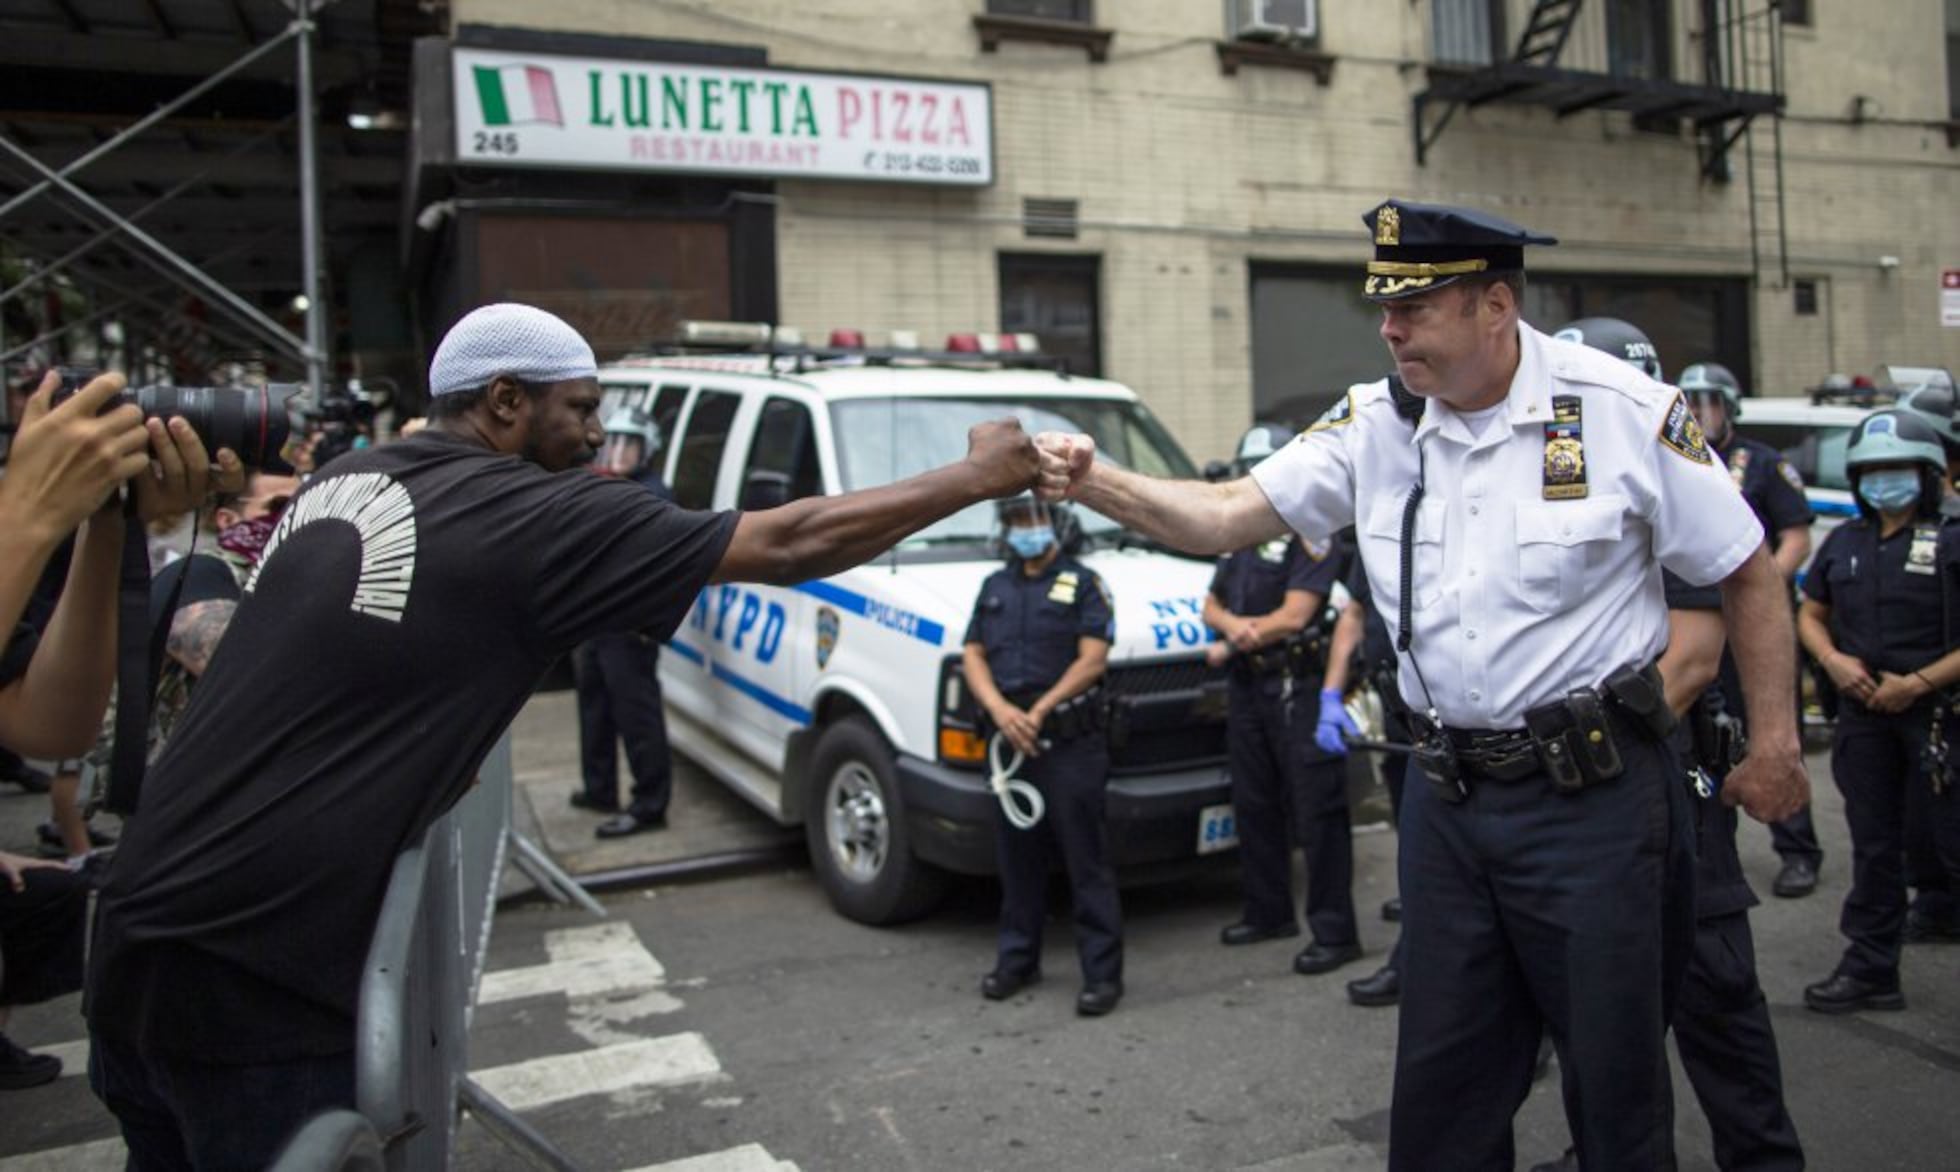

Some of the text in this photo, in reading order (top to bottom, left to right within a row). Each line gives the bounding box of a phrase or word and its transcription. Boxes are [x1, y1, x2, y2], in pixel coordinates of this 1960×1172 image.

[587, 70, 972, 146] LUNETTA PIZZA
[473, 130, 519, 155] 245
[629, 135, 821, 167] RESTAURANT
[864, 597, 919, 637] POLICE
